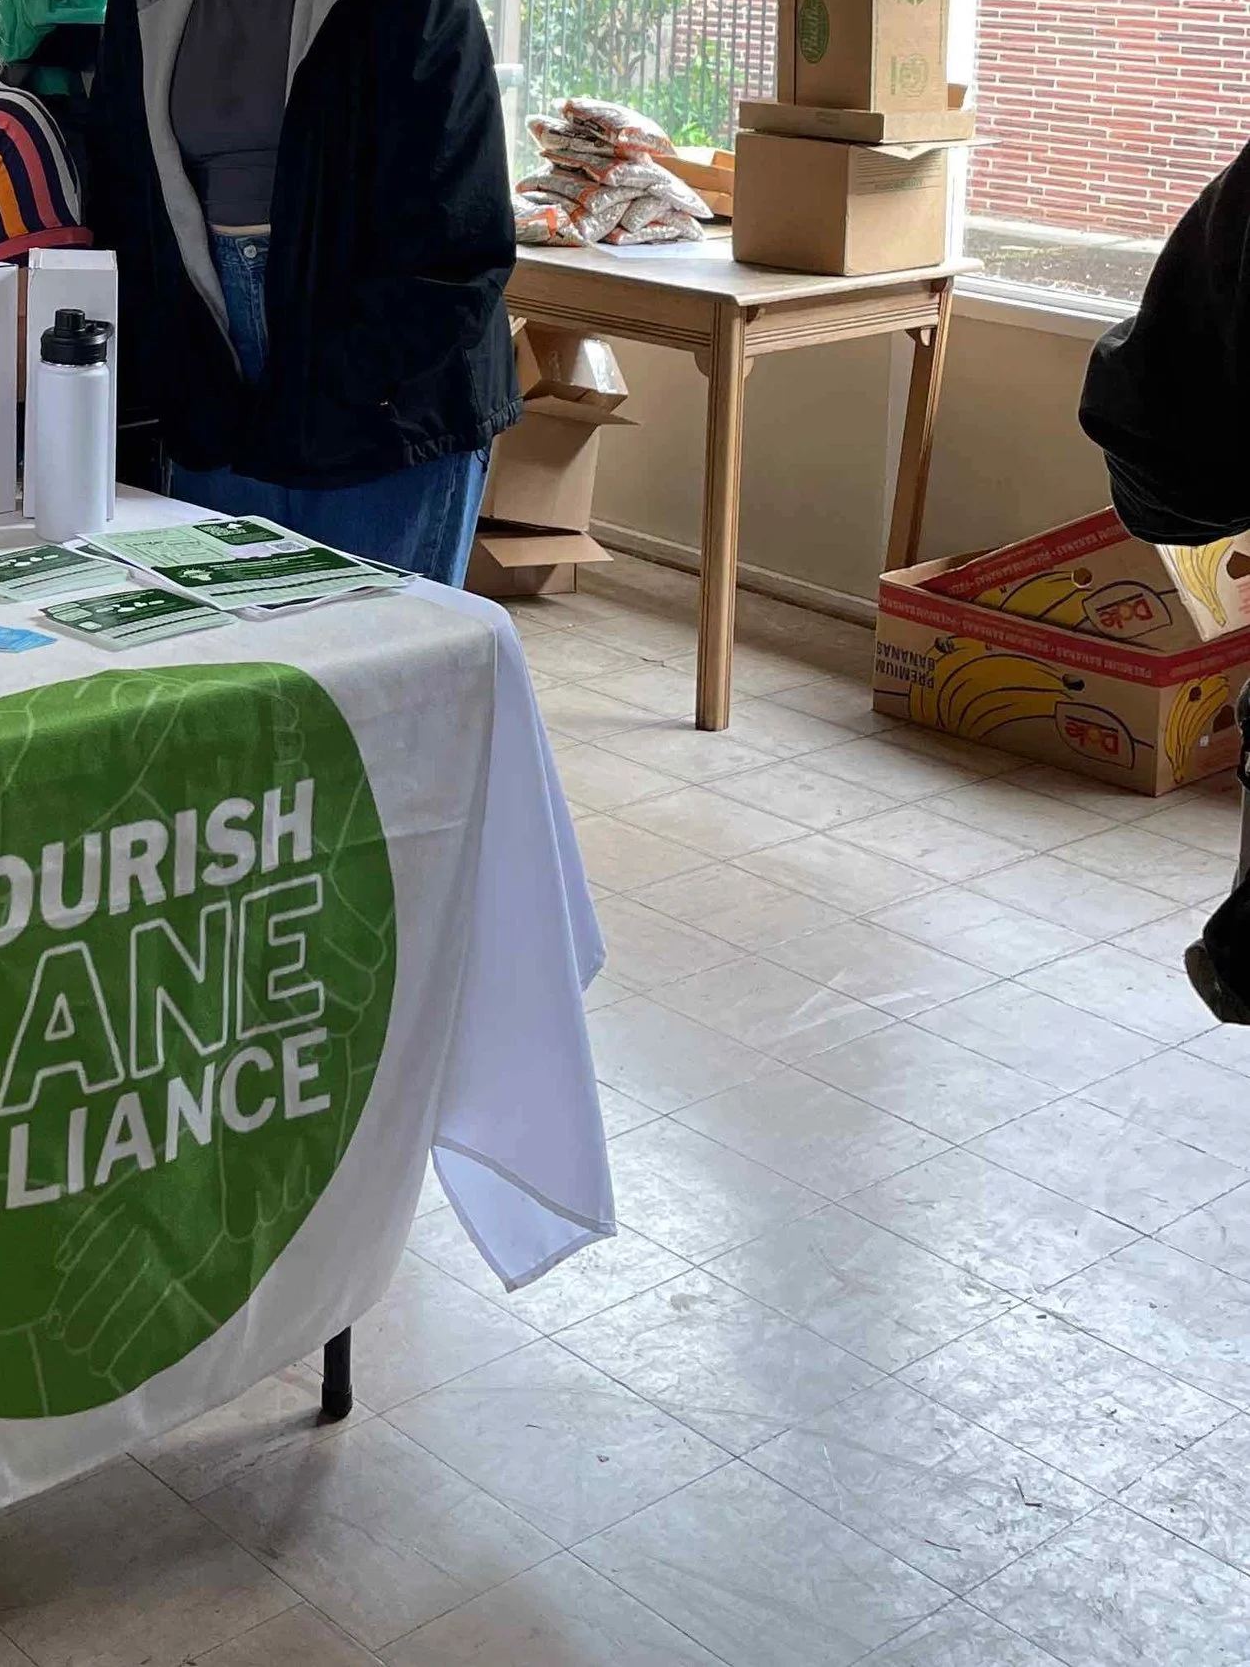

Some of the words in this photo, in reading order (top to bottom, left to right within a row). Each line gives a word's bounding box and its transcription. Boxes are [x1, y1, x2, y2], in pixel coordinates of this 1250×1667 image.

[1098, 598, 1155, 630] Dole
[876, 640, 936, 672] BANANAS
[875, 658, 935, 689] PREMIUM
[1065, 720, 1120, 756] Dole
